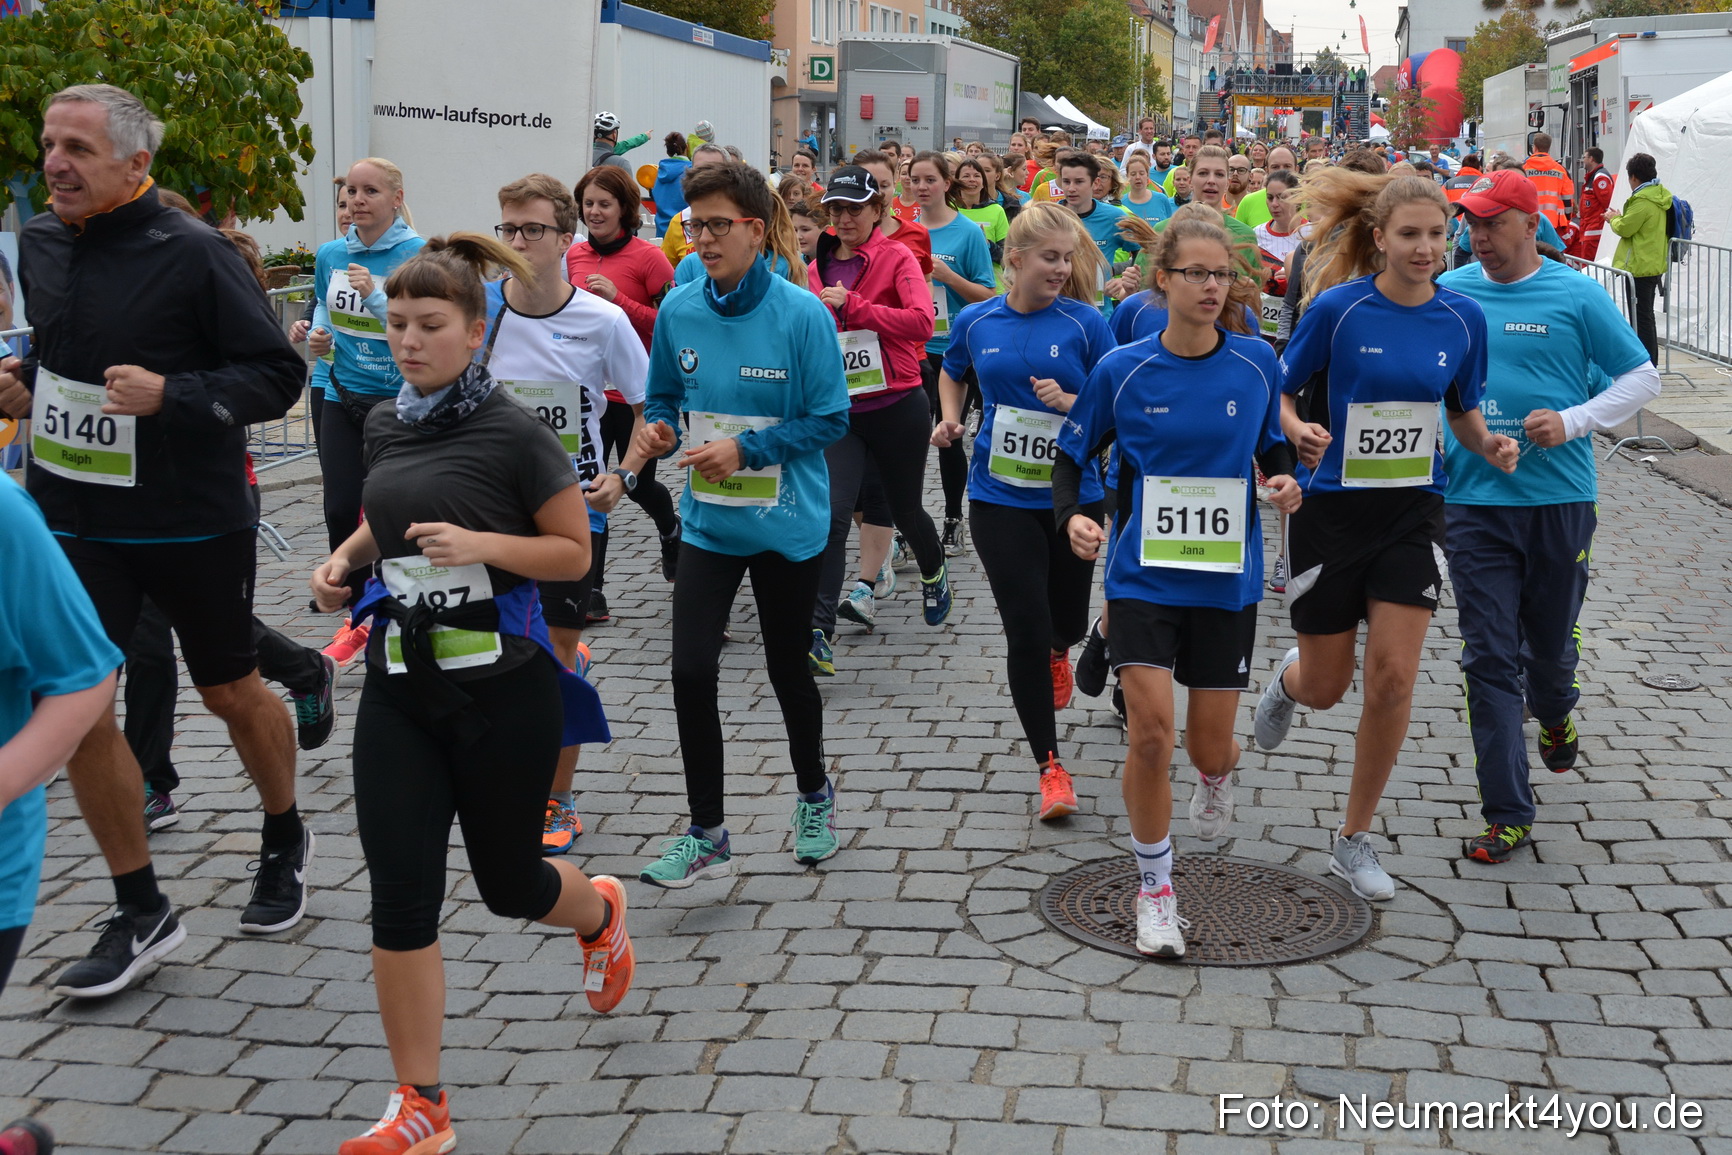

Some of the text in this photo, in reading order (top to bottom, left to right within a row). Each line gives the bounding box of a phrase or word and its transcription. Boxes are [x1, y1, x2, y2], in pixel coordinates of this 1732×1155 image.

[814, 60, 830, 77] D
[1274, 97, 1295, 106] ZIEL
[373, 102, 552, 129] www.bmw-laufsport.de
[1528, 170, 1562, 179] NOTARZT
[348, 317, 370, 327] Andrea
[1505, 323, 1547, 334] BOCK
[356, 342, 374, 355] 18.
[1050, 345, 1059, 357] 8
[1438, 351, 1447, 367] 2
[740, 367, 787, 379] BOCK
[1226, 400, 1237, 417] 6
[45, 404, 117, 446] 5140
[1003, 431, 1060, 461] 5166
[1358, 428, 1422, 454] 5237
[61, 449, 92, 465] Ralph
[1016, 464, 1042, 476] Hanna
[719, 480, 742, 491] Klara
[1181, 486, 1216, 494] BOCK
[1156, 507, 1229, 536] 5116
[1180, 545, 1205, 556] Jana
[1143, 871, 1157, 886] 6
